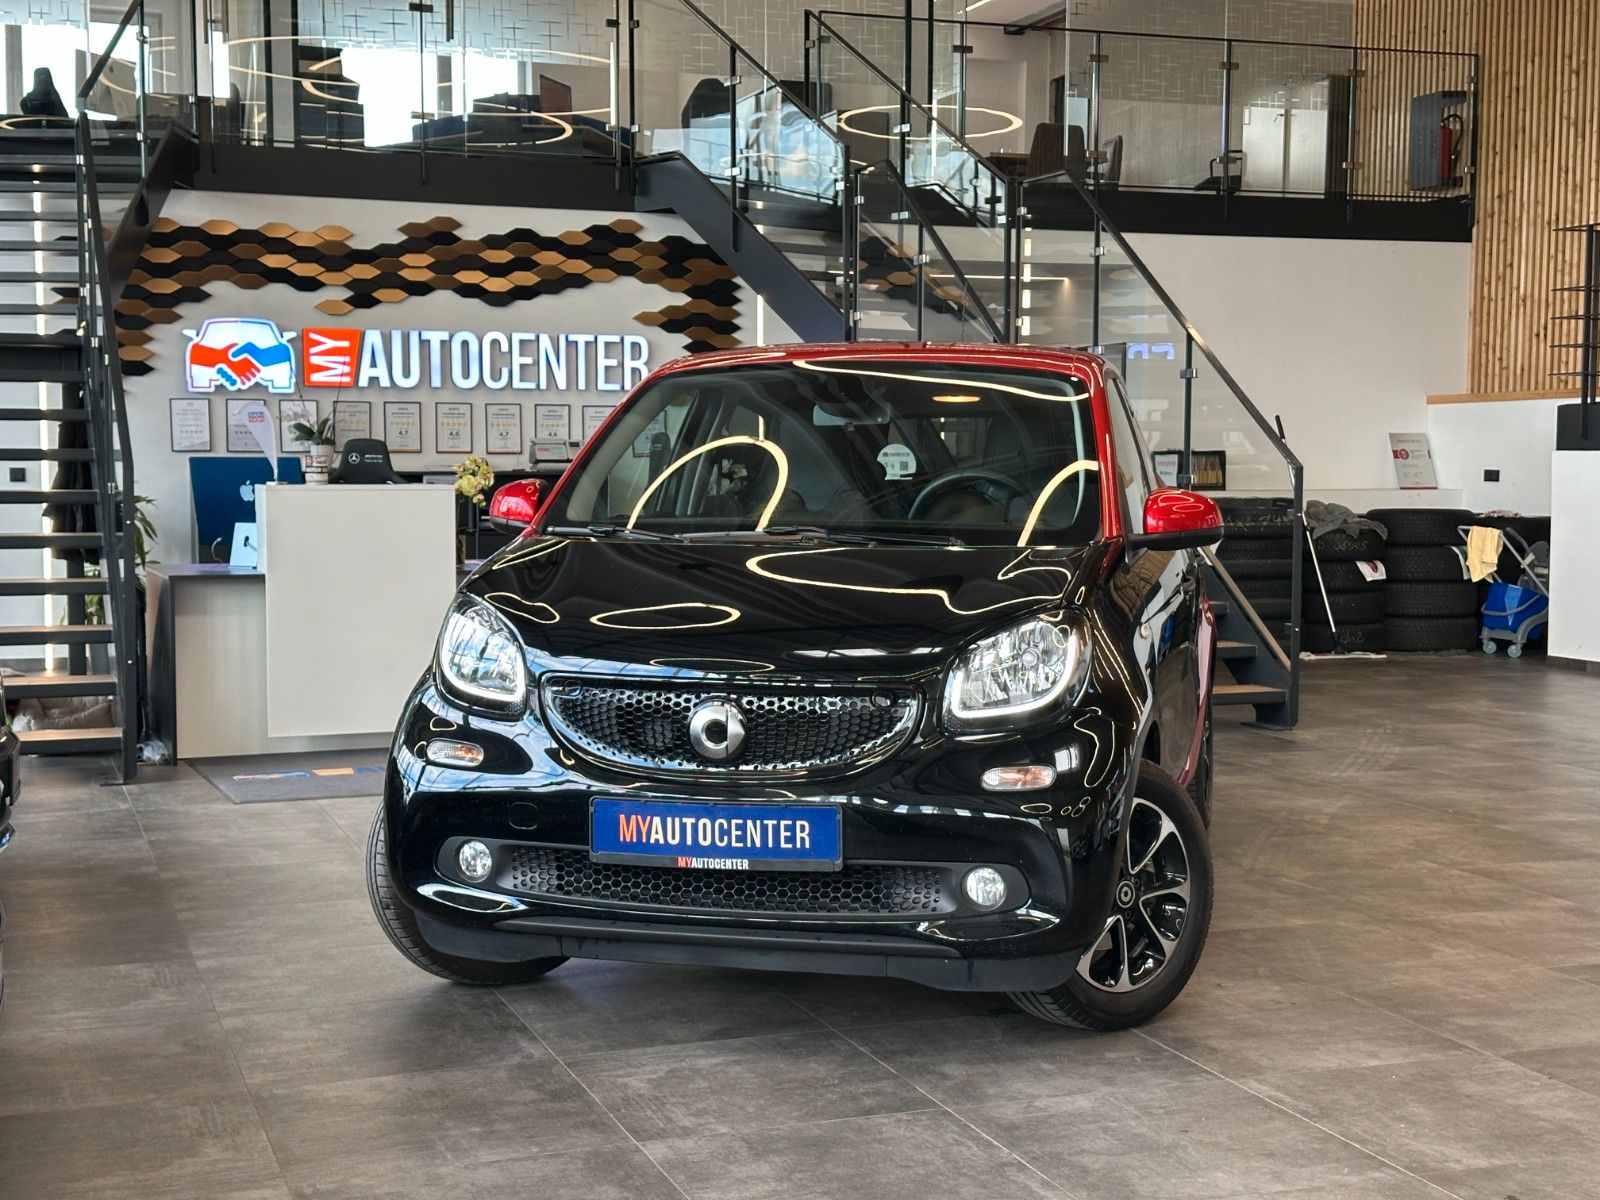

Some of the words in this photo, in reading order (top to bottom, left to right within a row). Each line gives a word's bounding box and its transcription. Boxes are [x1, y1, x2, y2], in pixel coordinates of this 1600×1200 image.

[309, 332, 351, 383] MY
[358, 329, 650, 391] AUTOCENTER
[619, 814, 810, 849] MYAUTOCENTER
[677, 857, 749, 870] MYAUTOCENTER
